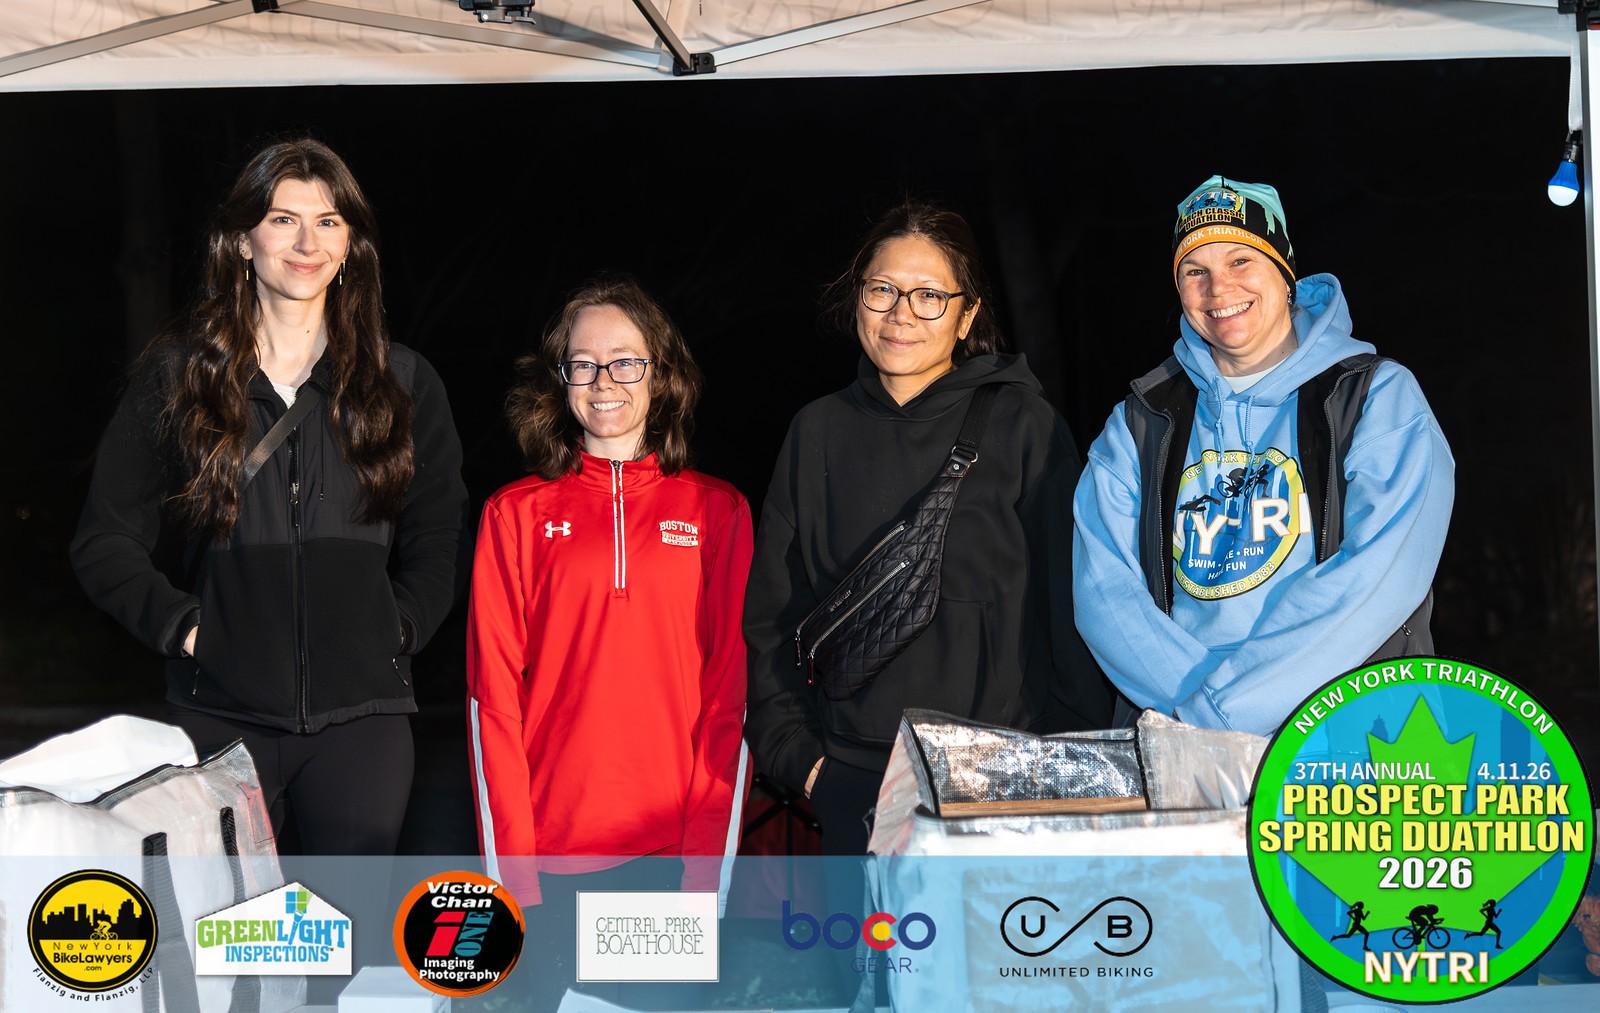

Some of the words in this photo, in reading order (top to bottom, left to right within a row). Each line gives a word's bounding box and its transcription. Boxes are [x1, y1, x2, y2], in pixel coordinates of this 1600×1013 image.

[1205, 207, 1245, 221] CLASSIC
[1185, 214, 1232, 232] DUATHLON
[1182, 230, 1206, 248] YORK
[1207, 227, 1263, 246] TRIATHLON
[1185, 463, 1204, 479] NE
[659, 520, 698, 535] BOSTON
[1188, 558, 1216, 568] SWIM
[1243, 546, 1264, 557] RUN
[1226, 561, 1247, 572] FUN
[1179, 575, 1247, 598] ESTABLISHED
[1249, 562, 1276, 585] 1983
